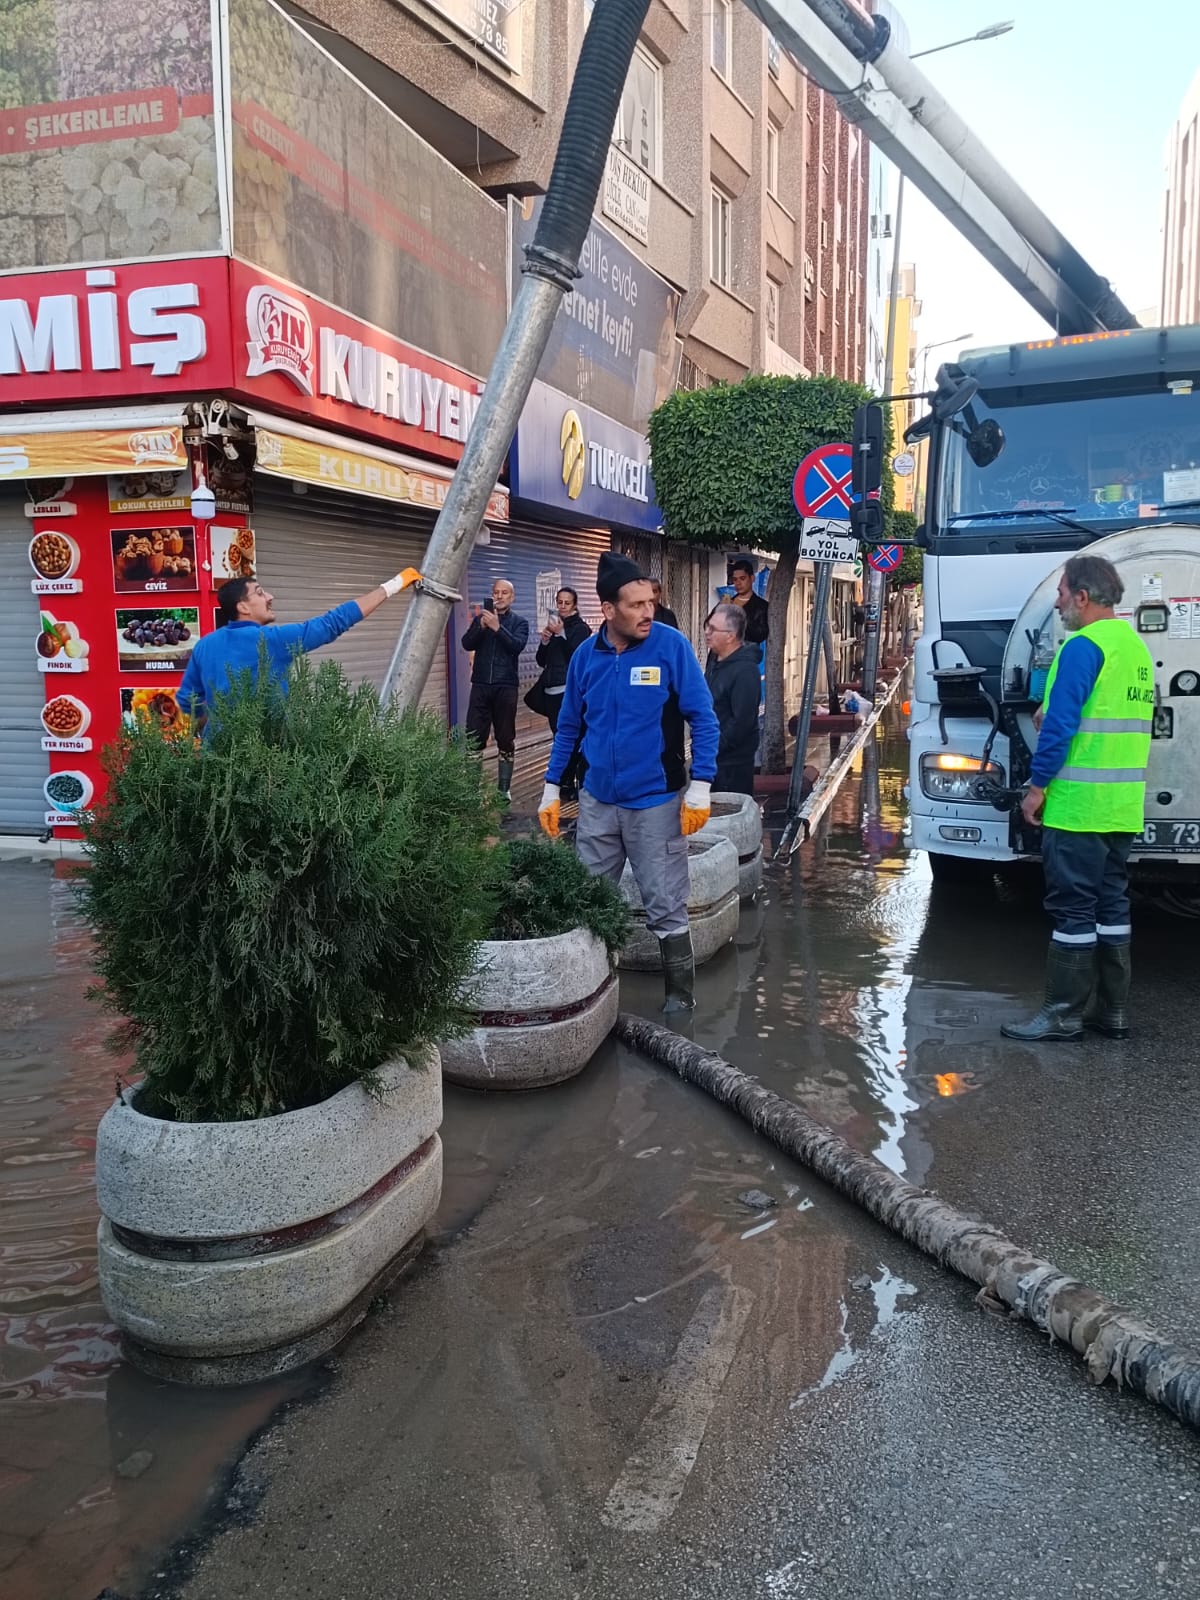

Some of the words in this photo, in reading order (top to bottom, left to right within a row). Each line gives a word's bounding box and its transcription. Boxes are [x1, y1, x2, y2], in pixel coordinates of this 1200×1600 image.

[480, 18, 493, 43] 78
[495, 31, 508, 55] 85
[25, 100, 163, 144] ŞEKERLEME
[622, 163, 648, 202] HEKİMİ
[580, 231, 609, 284] ell'le
[611, 264, 638, 306] evde
[0, 269, 207, 376] MİŞ
[560, 290, 600, 333] ernet
[601, 299, 634, 357] keyfi!
[588, 440, 649, 503] TURKCELL
[33, 504, 61, 513] LEBLEBİ
[118, 501, 146, 510] LOKUM
[148, 499, 185, 511] ÇEŞİTLERİ
[801, 548, 854, 561] BOYUNCA
[818, 540, 839, 549] YOL
[52, 583, 73, 592] ÇEREZ
[144, 580, 168, 590] CEVİZ
[145, 661, 175, 670] HURMA
